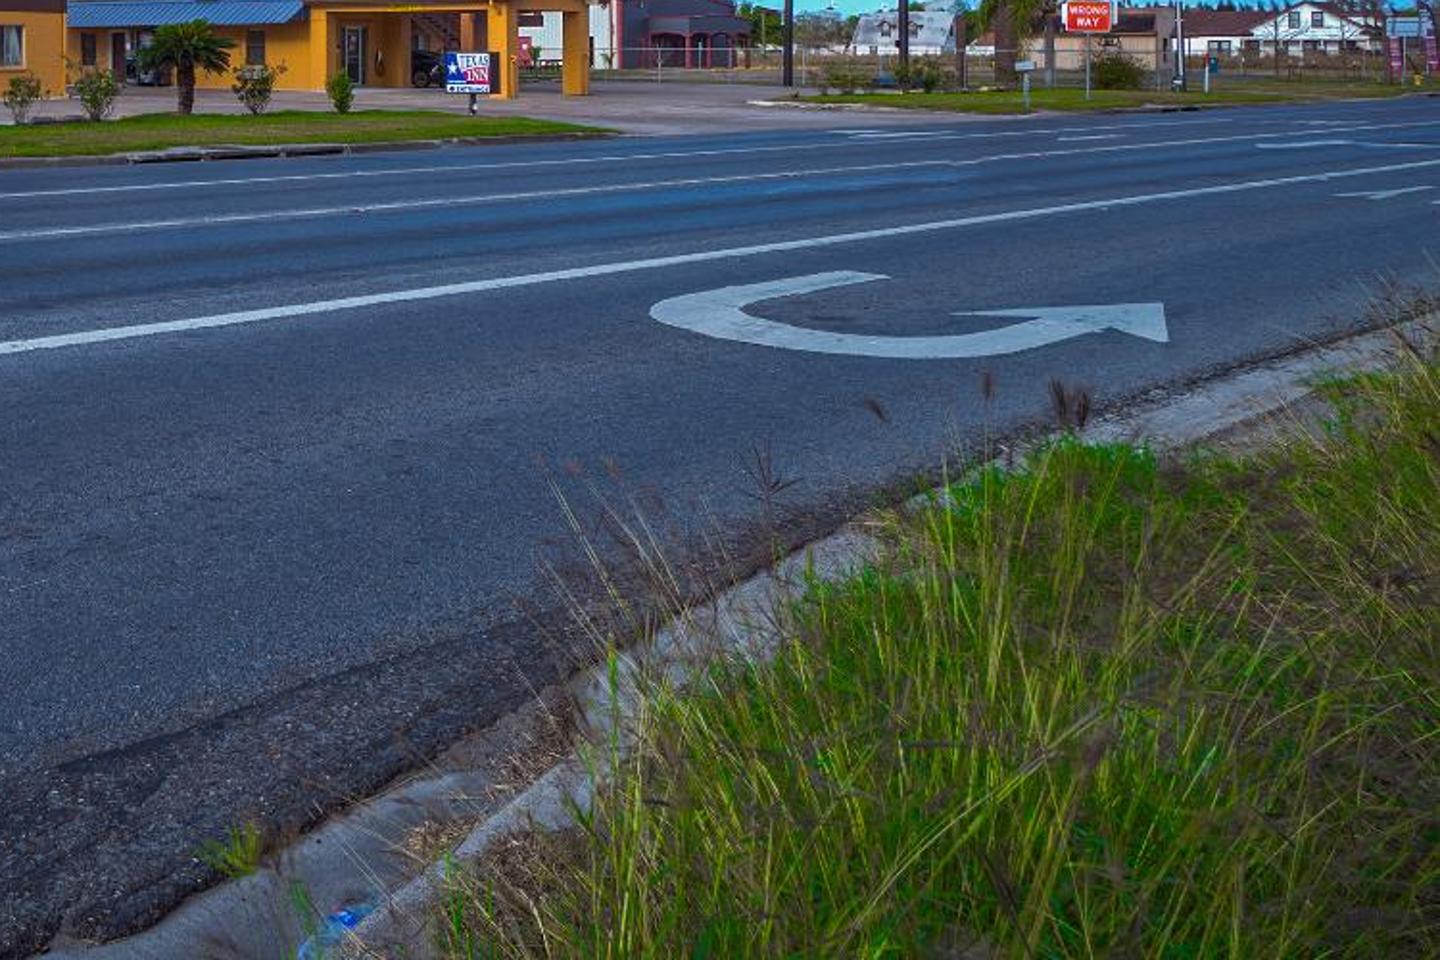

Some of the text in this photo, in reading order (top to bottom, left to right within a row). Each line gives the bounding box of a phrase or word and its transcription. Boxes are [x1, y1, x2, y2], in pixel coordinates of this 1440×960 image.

[1069, 5, 1108, 15] WRONG
[1076, 17, 1100, 27] WAY
[466, 68, 488, 81] INN
